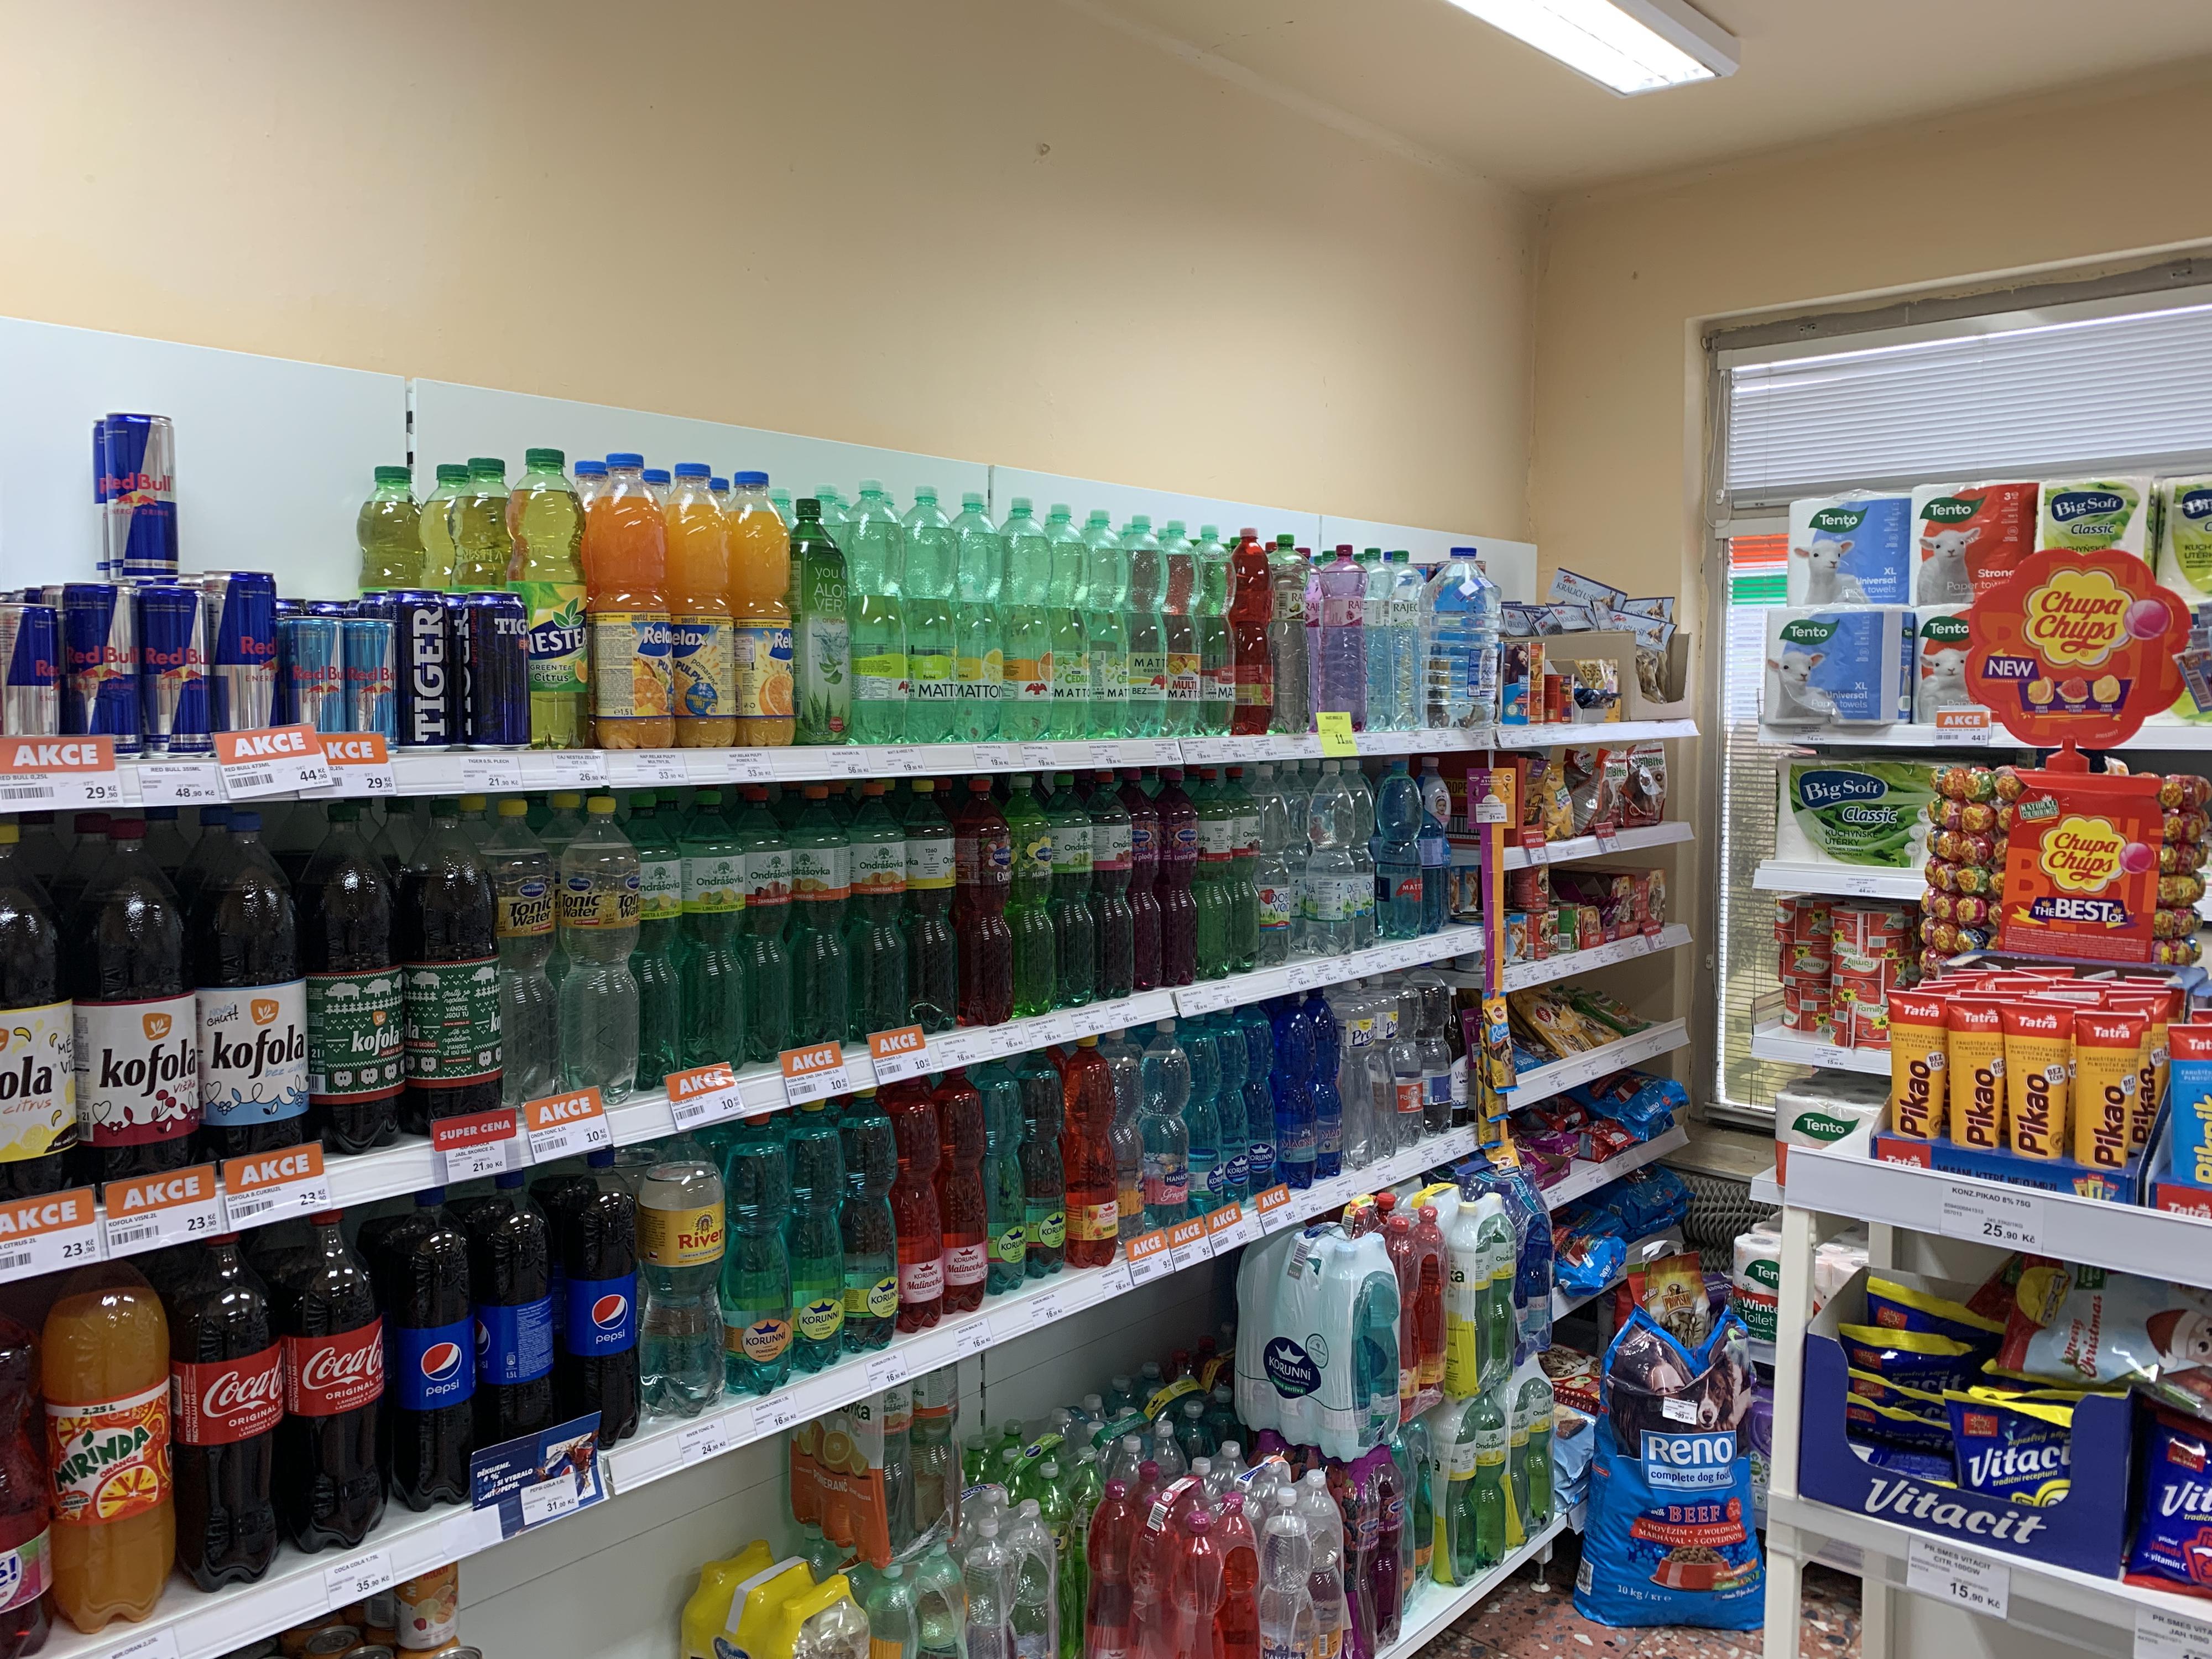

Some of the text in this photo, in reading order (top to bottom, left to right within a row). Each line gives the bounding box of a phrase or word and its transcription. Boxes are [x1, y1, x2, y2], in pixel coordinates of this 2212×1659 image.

[1931, 504, 1971, 517] Tento
[1819, 514, 1858, 528] Tento
[2071, 523, 2115, 534] Classic
[815, 567, 838, 580] you
[1884, 567, 1897, 576] XL
[1856, 577, 1897, 585] Universal
[1947, 581, 1978, 592] Paper
[814, 583, 847, 598] ALOE
[1867, 585, 1897, 594] towels
[2042, 591, 2124, 619] Chupa
[1790, 627, 1828, 637] Tento
[1930, 623, 1969, 634] Tento
[2034, 615, 2117, 653] Chups
[241, 636, 276, 655] Red
[145, 647, 182, 665] Red
[293, 666, 324, 680] Red
[348, 667, 377, 681] Red
[413, 607, 445, 742] TIGER
[1989, 660, 2033, 677] NEW
[534, 673, 569, 682] Citrus
[1172, 681, 1197, 690] MULTI
[1826, 691, 1868, 700] Universal
[1944, 716, 1980, 725] AKCE
[234, 732, 306, 758] AKCE
[13, 744, 98, 766] AKCE
[300, 770, 317, 781] 44
[367, 779, 383, 789] 29
[86, 787, 105, 799] 29
[2021, 801, 2057, 811] NATURAL
[2022, 808, 2058, 818] COLOURINGS
[1844, 807, 1897, 822] Classic
[1825, 829, 1879, 838] KUCHYŇSKÉ
[2054, 833, 2119, 855] Chupa
[860, 859, 903, 870] Ondrášovka
[2049, 851, 2114, 881] Chups
[696, 873, 744, 886] Ondrášovka
[509, 898, 552, 917] Tonic
[562, 893, 602, 909] Tonic
[563, 900, 598, 917] Water
[512, 910, 551, 927] Water
[2035, 899, 2124, 922] THE BEST OF
[1857, 1003, 1884, 1013] Family
[1903, 1004, 1940, 1018] Tatra
[1964, 1011, 1999, 1023] Tatra
[2019, 1016, 2057, 1029] Tatra
[351, 1025, 400, 1056] kofola
[2094, 1026, 2130, 1039] Tatra
[880, 1033, 917, 1053] AKCE
[211, 1024, 305, 1079] kofola
[100, 1039, 196, 1097] kofola
[792, 1050, 834, 1072] AKCE
[915, 1061, 925, 1070] 10
[680, 1071, 723, 1095] AKCE
[831, 1080, 842, 1089] 10
[3, 1098, 52, 1114] citrus
[722, 1099, 734, 1109] 10
[1900, 1060, 1931, 1139] Pikao
[1965, 1068, 1995, 1147] Pikao
[539, 1097, 592, 1124] AKCE
[2017, 1074, 2050, 1156] Pikao
[440, 1120, 511, 1141] SUPER CENA
[1804, 1118, 1845, 1134] Tento
[2093, 1086, 2125, 1168] Pikao
[586, 1130, 599, 1143] 10
[241, 1154, 310, 1186] AKCE
[123, 1176, 200, 1210] AKCE
[300, 1192, 316, 1206] 23
[1262, 1190, 1286, 1208] AKCE
[2002, 1197, 2014, 1205] 8%
[2016, 1199, 2031, 1208] 75G
[187, 1217, 205, 1231] 23
[1213, 1208, 1237, 1229] AKCE
[678, 1228, 723, 1249] River
[1175, 1223, 1199, 1243] AKCE
[1983, 1222, 2035, 1243] 25,90 Kč
[4, 1239, 28, 1248] CITRUS
[62, 1243, 82, 1258] 23
[1134, 1235, 1161, 1257] AKCE
[946, 1261, 985, 1273] Malinovka
[802, 1309, 839, 1326] KORUNNÍ
[1743, 1310, 1774, 1327] Toilet
[596, 1328, 625, 1344] pepsi
[746, 1329, 786, 1346] KORUNNÍ
[1269, 1356, 1311, 1381] KORUNNÍ
[325, 1380, 374, 1400] ORIGINAL
[426, 1379, 460, 1397] pepsi
[82, 1405, 106, 1415] 2,25
[228, 1406, 276, 1427] ORIGINAL
[698, 1426, 709, 1434] TONIC
[1648, 1437, 1733, 1465] Reno
[100, 1455, 138, 1478] ORANGE
[1651, 1469, 1730, 1483] complete dog food
[1992, 1470, 2058, 1486] tradiční receptura
[1651, 1505, 1720, 1523] with BEEF
[1865, 1478, 2047, 1544] Vitacit
[334, 1564, 349, 1574] COCA
[350, 1559, 365, 1568] COLA
[2180, 1562, 2187, 1571] C
[1618, 1584, 1642, 1600] 10 kg
